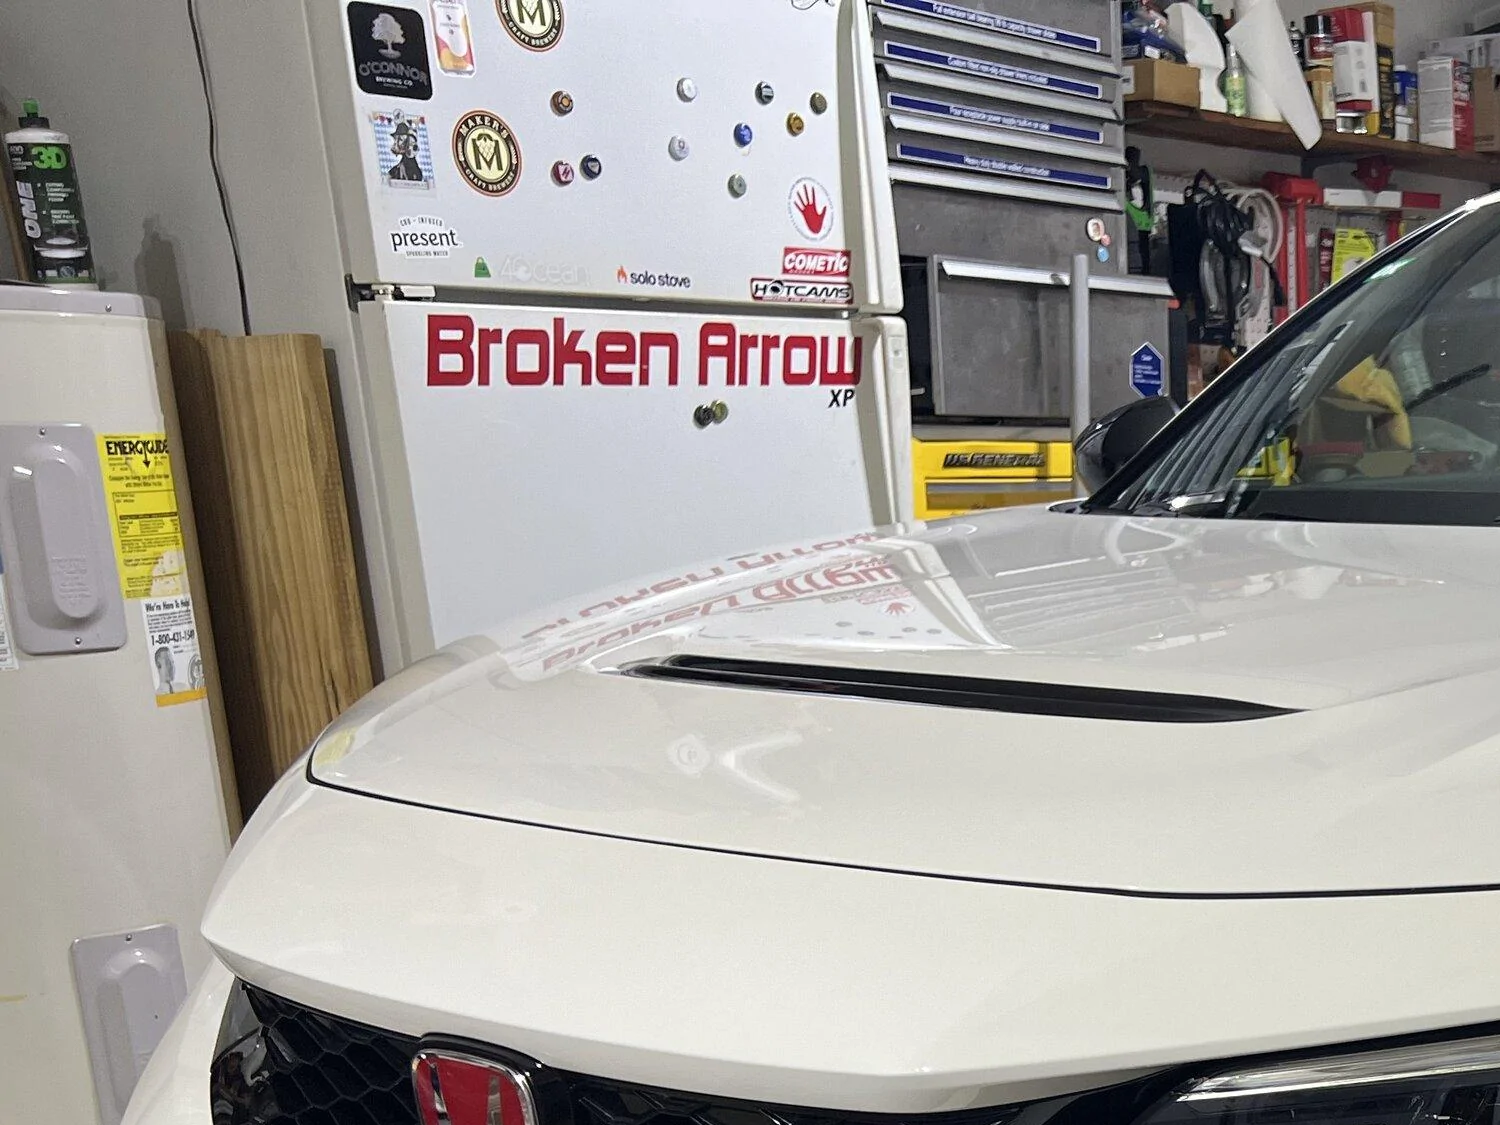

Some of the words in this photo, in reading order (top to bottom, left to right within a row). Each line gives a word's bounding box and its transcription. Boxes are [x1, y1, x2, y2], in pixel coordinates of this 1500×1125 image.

[358, 61, 428, 87] O'CONNOR
[31, 145, 67, 170] 3D
[16, 180, 41, 239] ONE
[390, 229, 459, 252] present
[784, 252, 848, 273] COMETIC
[630, 271, 656, 286] solo
[657, 273, 691, 289] stove
[426, 313, 679, 387] Broken
[698, 321, 863, 387] Arrow
[827, 388, 855, 408] XP
